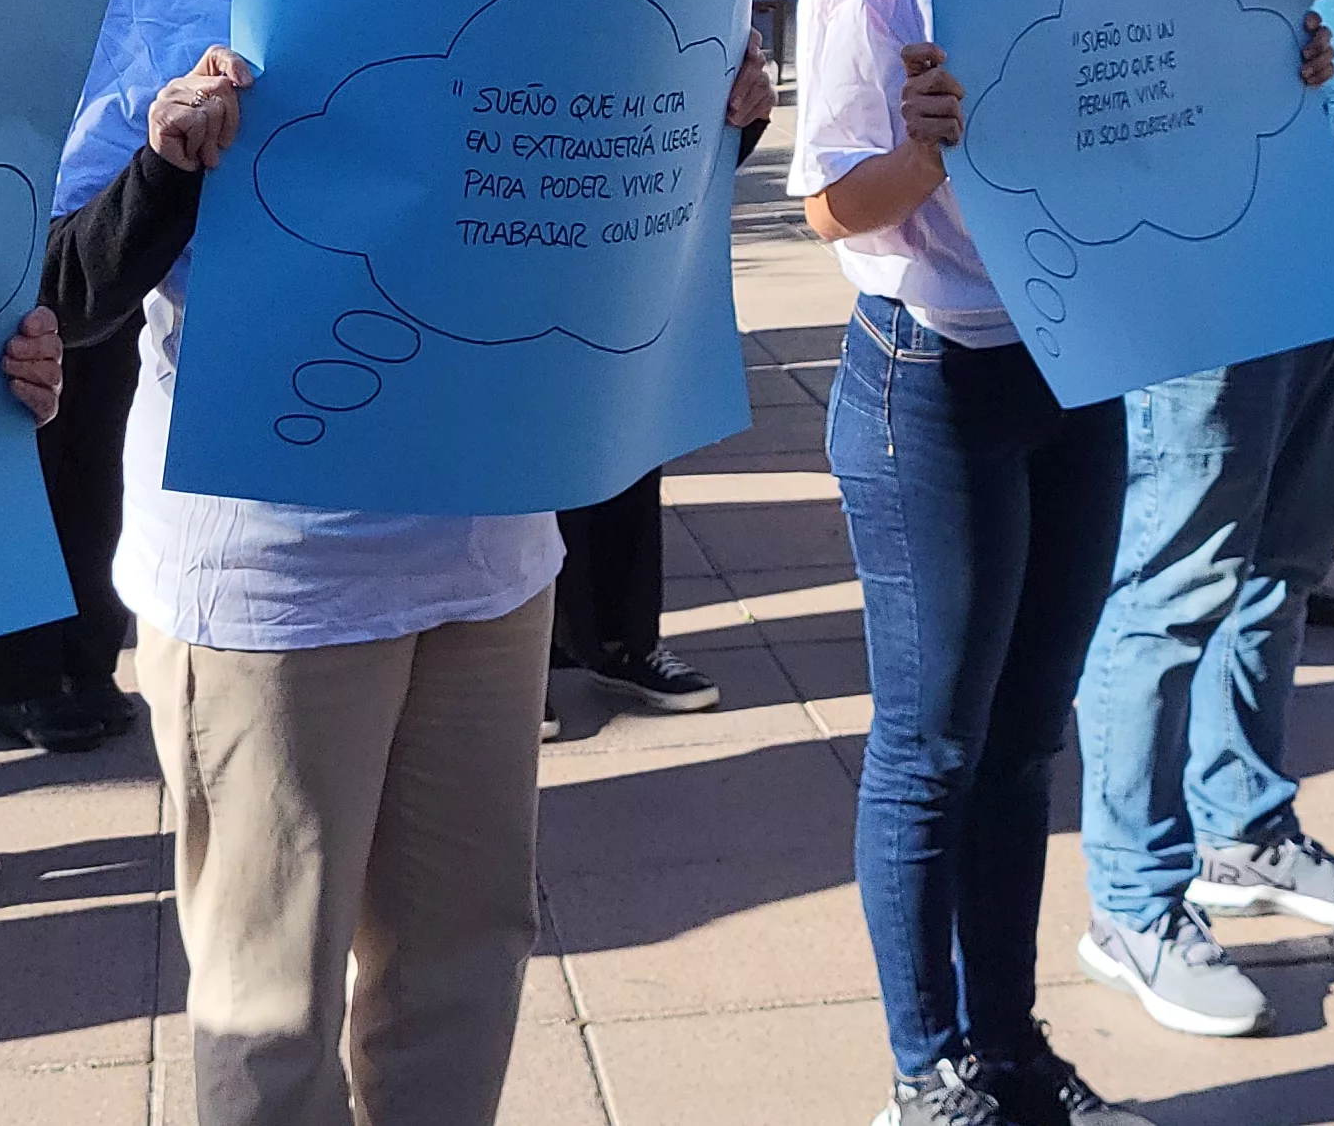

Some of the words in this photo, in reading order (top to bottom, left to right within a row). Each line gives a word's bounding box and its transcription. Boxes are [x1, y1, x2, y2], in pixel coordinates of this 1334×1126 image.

[1127, 23, 1152, 43] CON
[1158, 19, 1175, 39] UN
[1076, 59, 1129, 87] SUELDO
[1131, 54, 1154, 77] QUE
[570, 94, 615, 122] QUE
[622, 95, 645, 118] MI
[653, 91, 685, 114] CITA
[1078, 90, 1131, 117] PERMITA
[467, 130, 501, 153] EN
[513, 124, 655, 160] EXTRANJERÍA
[1076, 129, 1094, 152] NO
[464, 168, 526, 199] PARA
[540, 175, 612, 199] PODER
[622, 168, 664, 197] VIVIR
[670, 165, 682, 193] Y
[456, 220, 589, 248] TRABAJAR
[602, 219, 640, 243] CON
